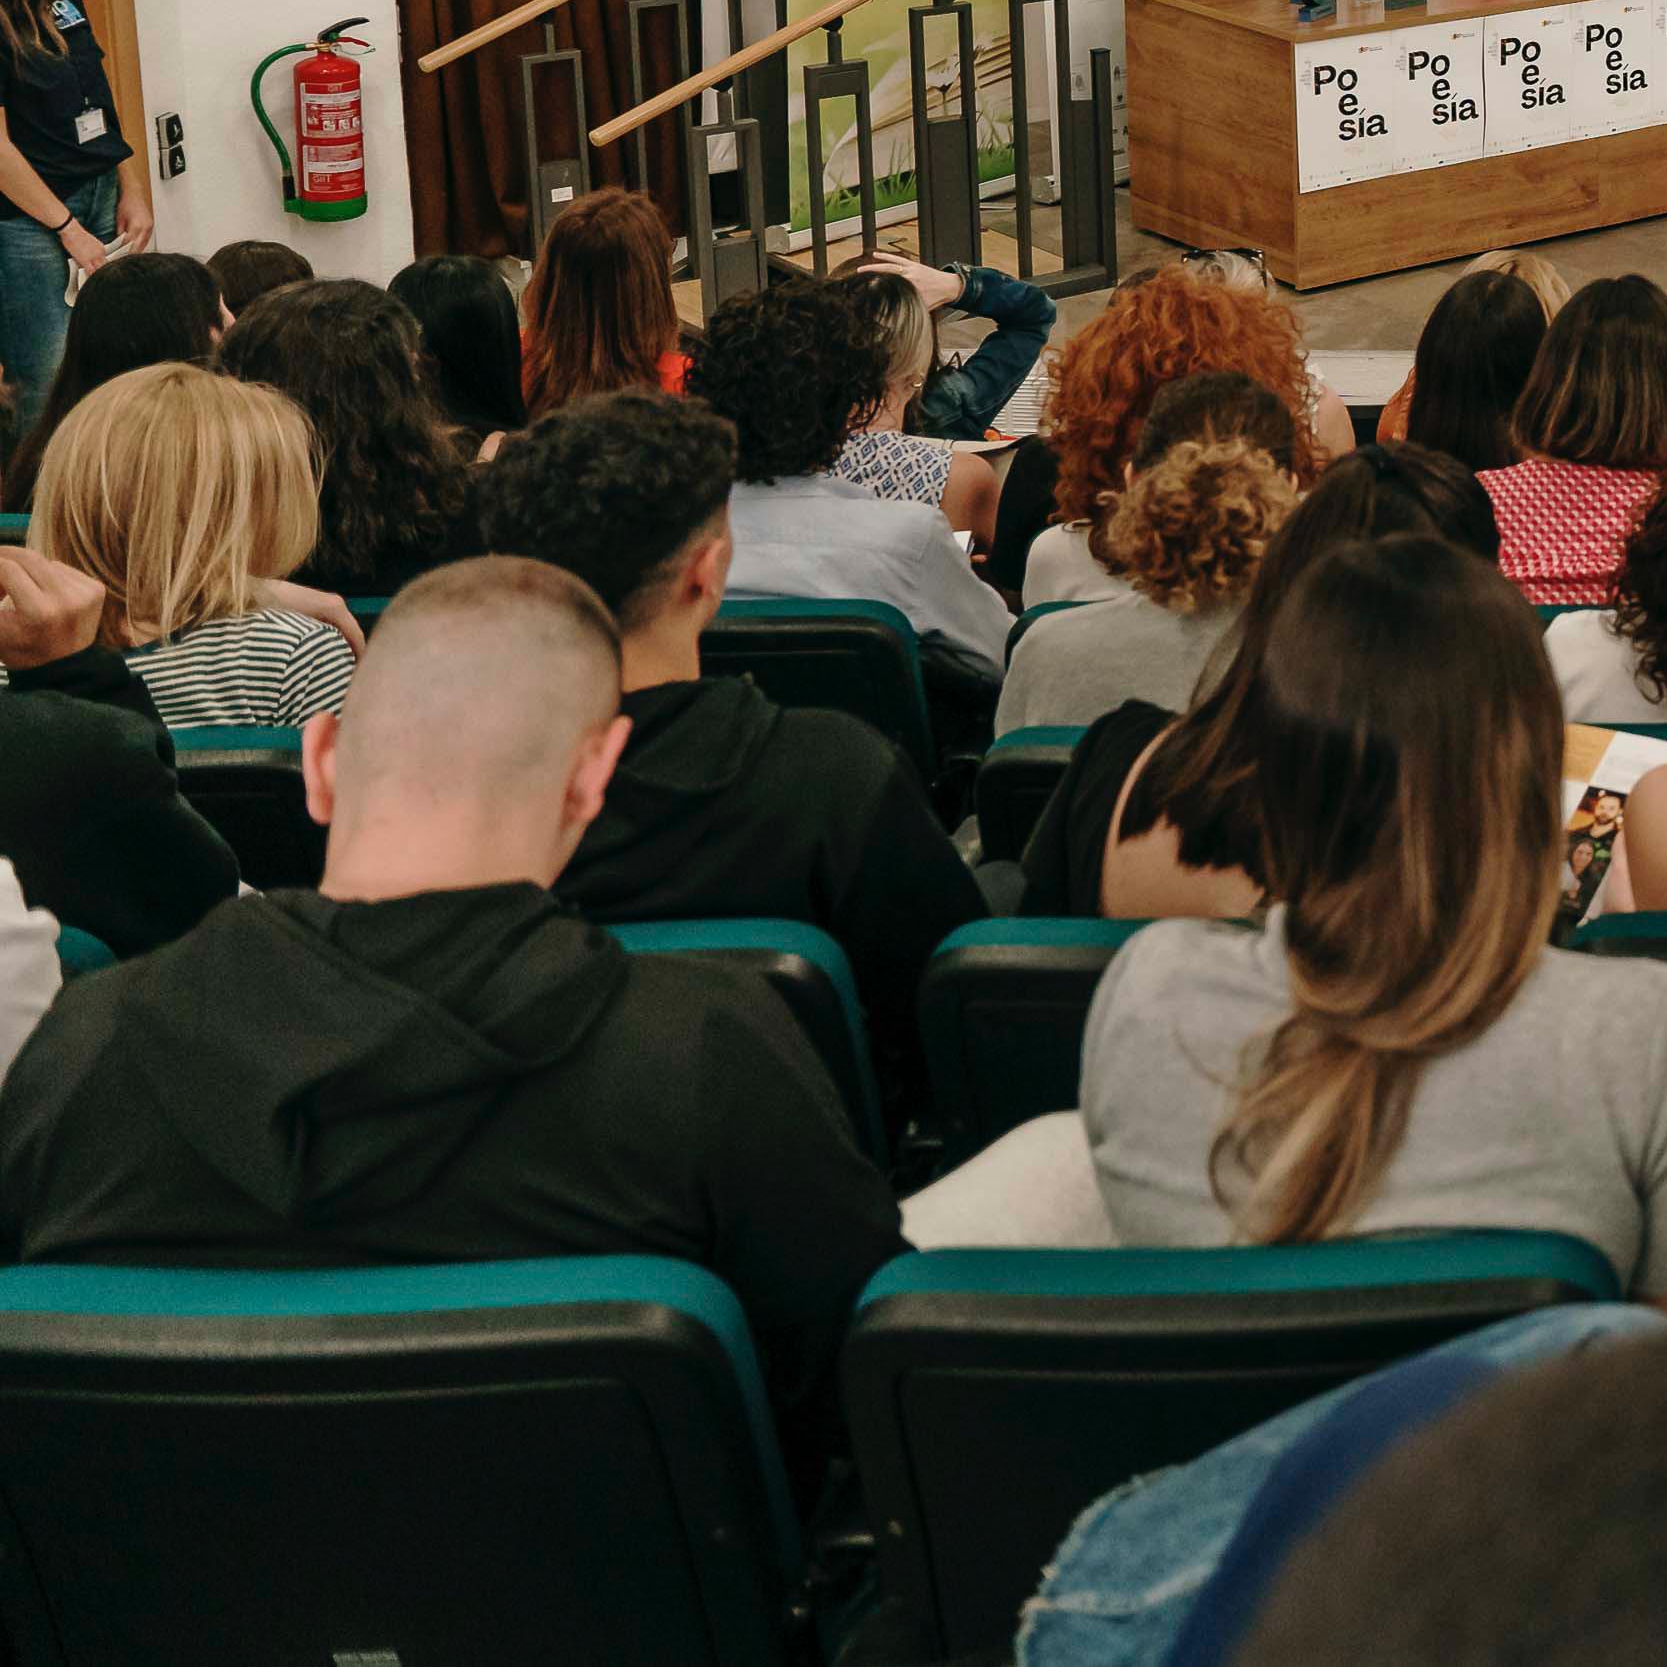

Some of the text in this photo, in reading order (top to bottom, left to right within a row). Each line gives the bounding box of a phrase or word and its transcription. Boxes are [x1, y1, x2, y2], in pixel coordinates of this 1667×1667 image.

[1500, 37, 1541, 66] Po
[1586, 23, 1623, 52] Po
[1408, 50, 1451, 80] Po
[1521, 64, 1540, 85] e
[1605, 50, 1623, 71] e
[1313, 65, 1358, 95] Po
[1432, 78, 1451, 100] e
[1605, 63, 1648, 95] sía
[1338, 93, 1358, 115] e
[1432, 92, 1479, 125] sía
[1521, 78, 1566, 110] sía
[1338, 107, 1388, 141] sía
